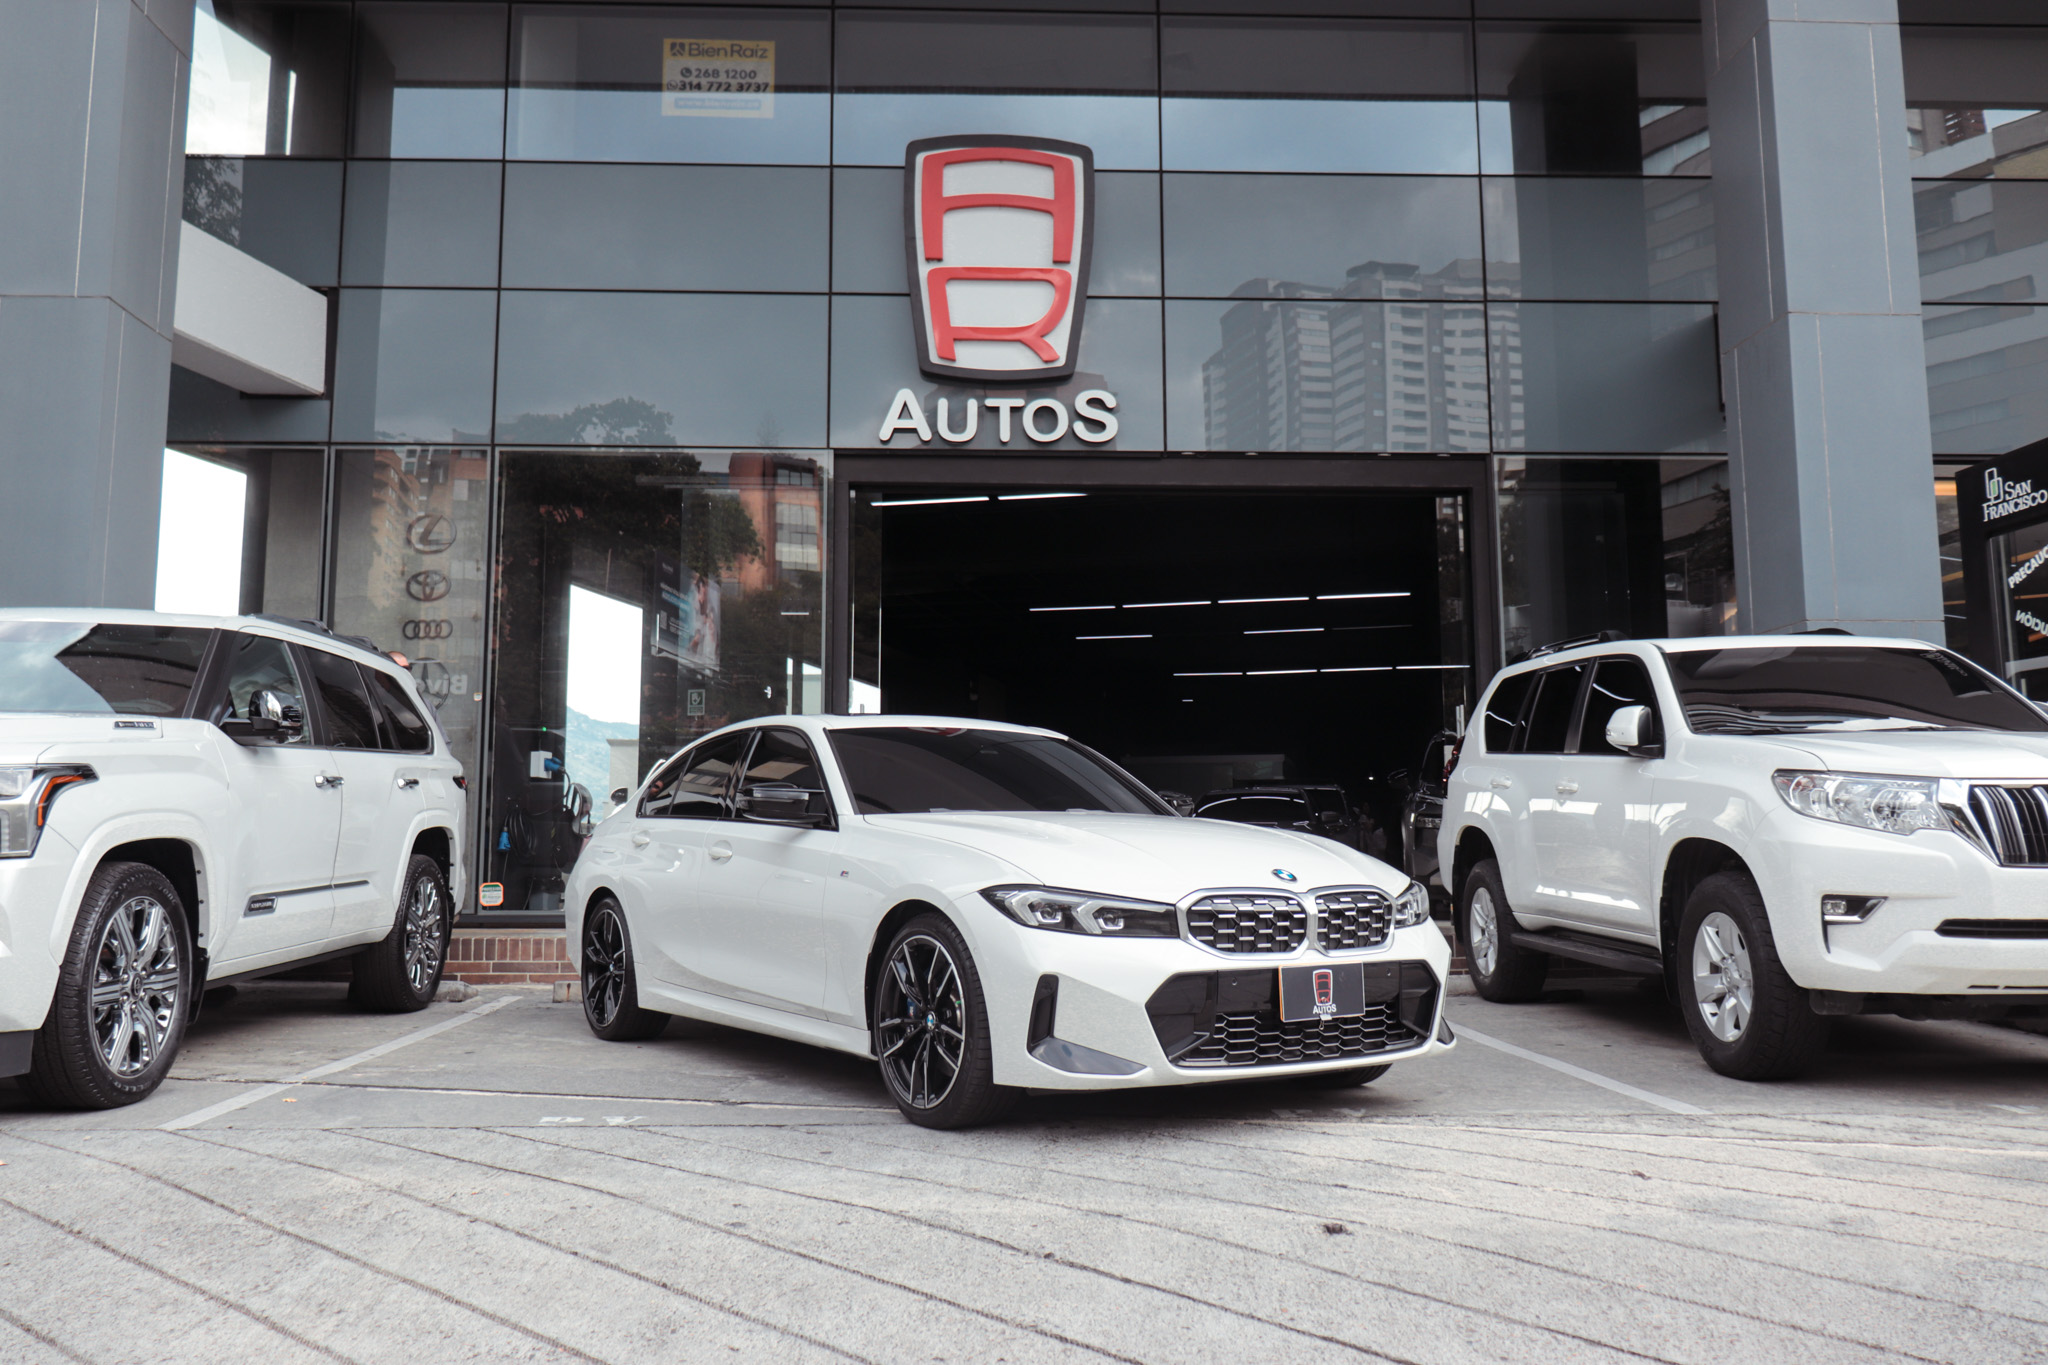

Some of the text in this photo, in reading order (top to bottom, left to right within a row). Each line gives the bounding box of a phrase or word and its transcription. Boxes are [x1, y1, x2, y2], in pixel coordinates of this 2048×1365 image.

[688, 42, 769, 59] Bien Raiz
[694, 68, 757, 80] 268 1200
[678, 81, 770, 93] 314 772 3737
[879, 388, 1119, 443] AUTOS
[2004, 479, 2032, 501] SAN
[1982, 489, 2048, 522] FRANCISCO
[1312, 1003, 1337, 1015] AUTOS
